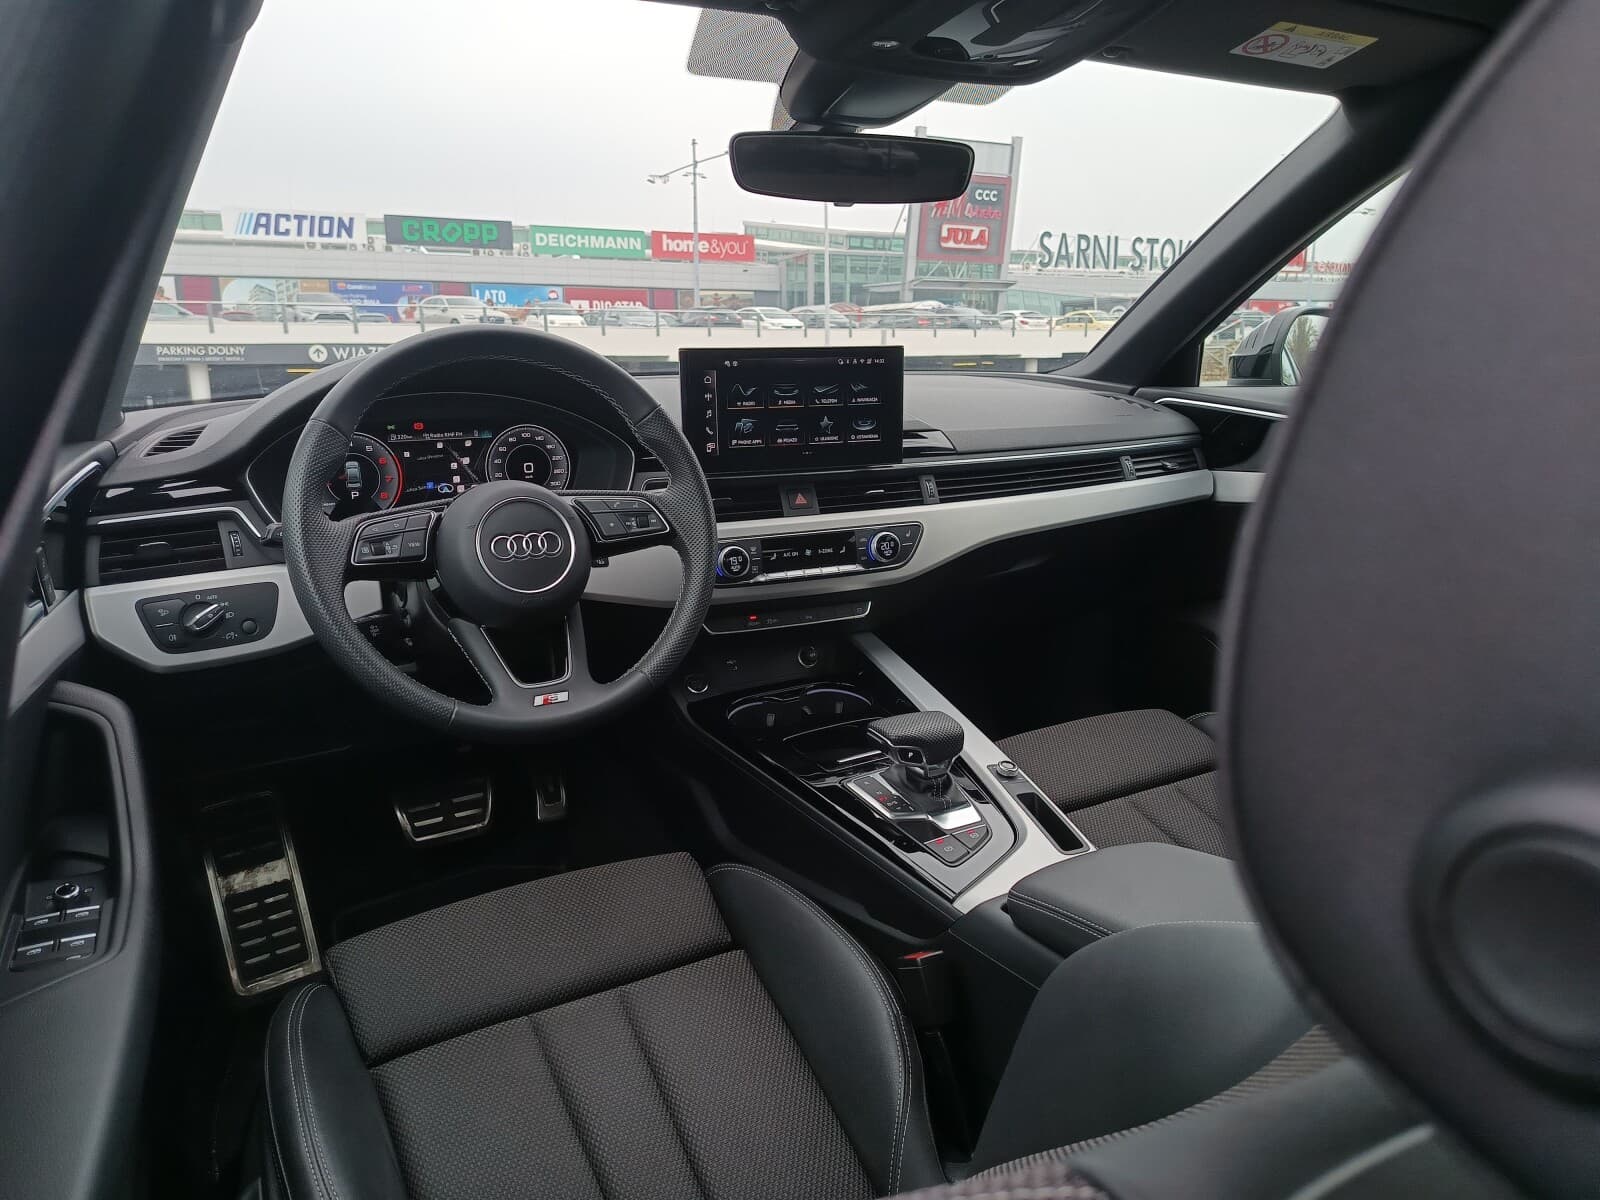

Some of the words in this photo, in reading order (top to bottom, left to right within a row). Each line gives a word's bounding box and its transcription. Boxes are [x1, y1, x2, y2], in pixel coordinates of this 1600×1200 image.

[974, 189, 998, 202] CCC
[252, 212, 354, 239] ACTION
[401, 219, 499, 245] CROPP
[535, 232, 642, 250] DEICHMANN
[941, 227, 988, 245] JULA
[661, 233, 747, 258] home&you
[1038, 231, 1119, 269] SARNI
[156, 345, 205, 356] PARKING
[208, 345, 246, 355] DOLNY
[523, 462, 534, 474] 0
[351, 491, 359, 499] P
